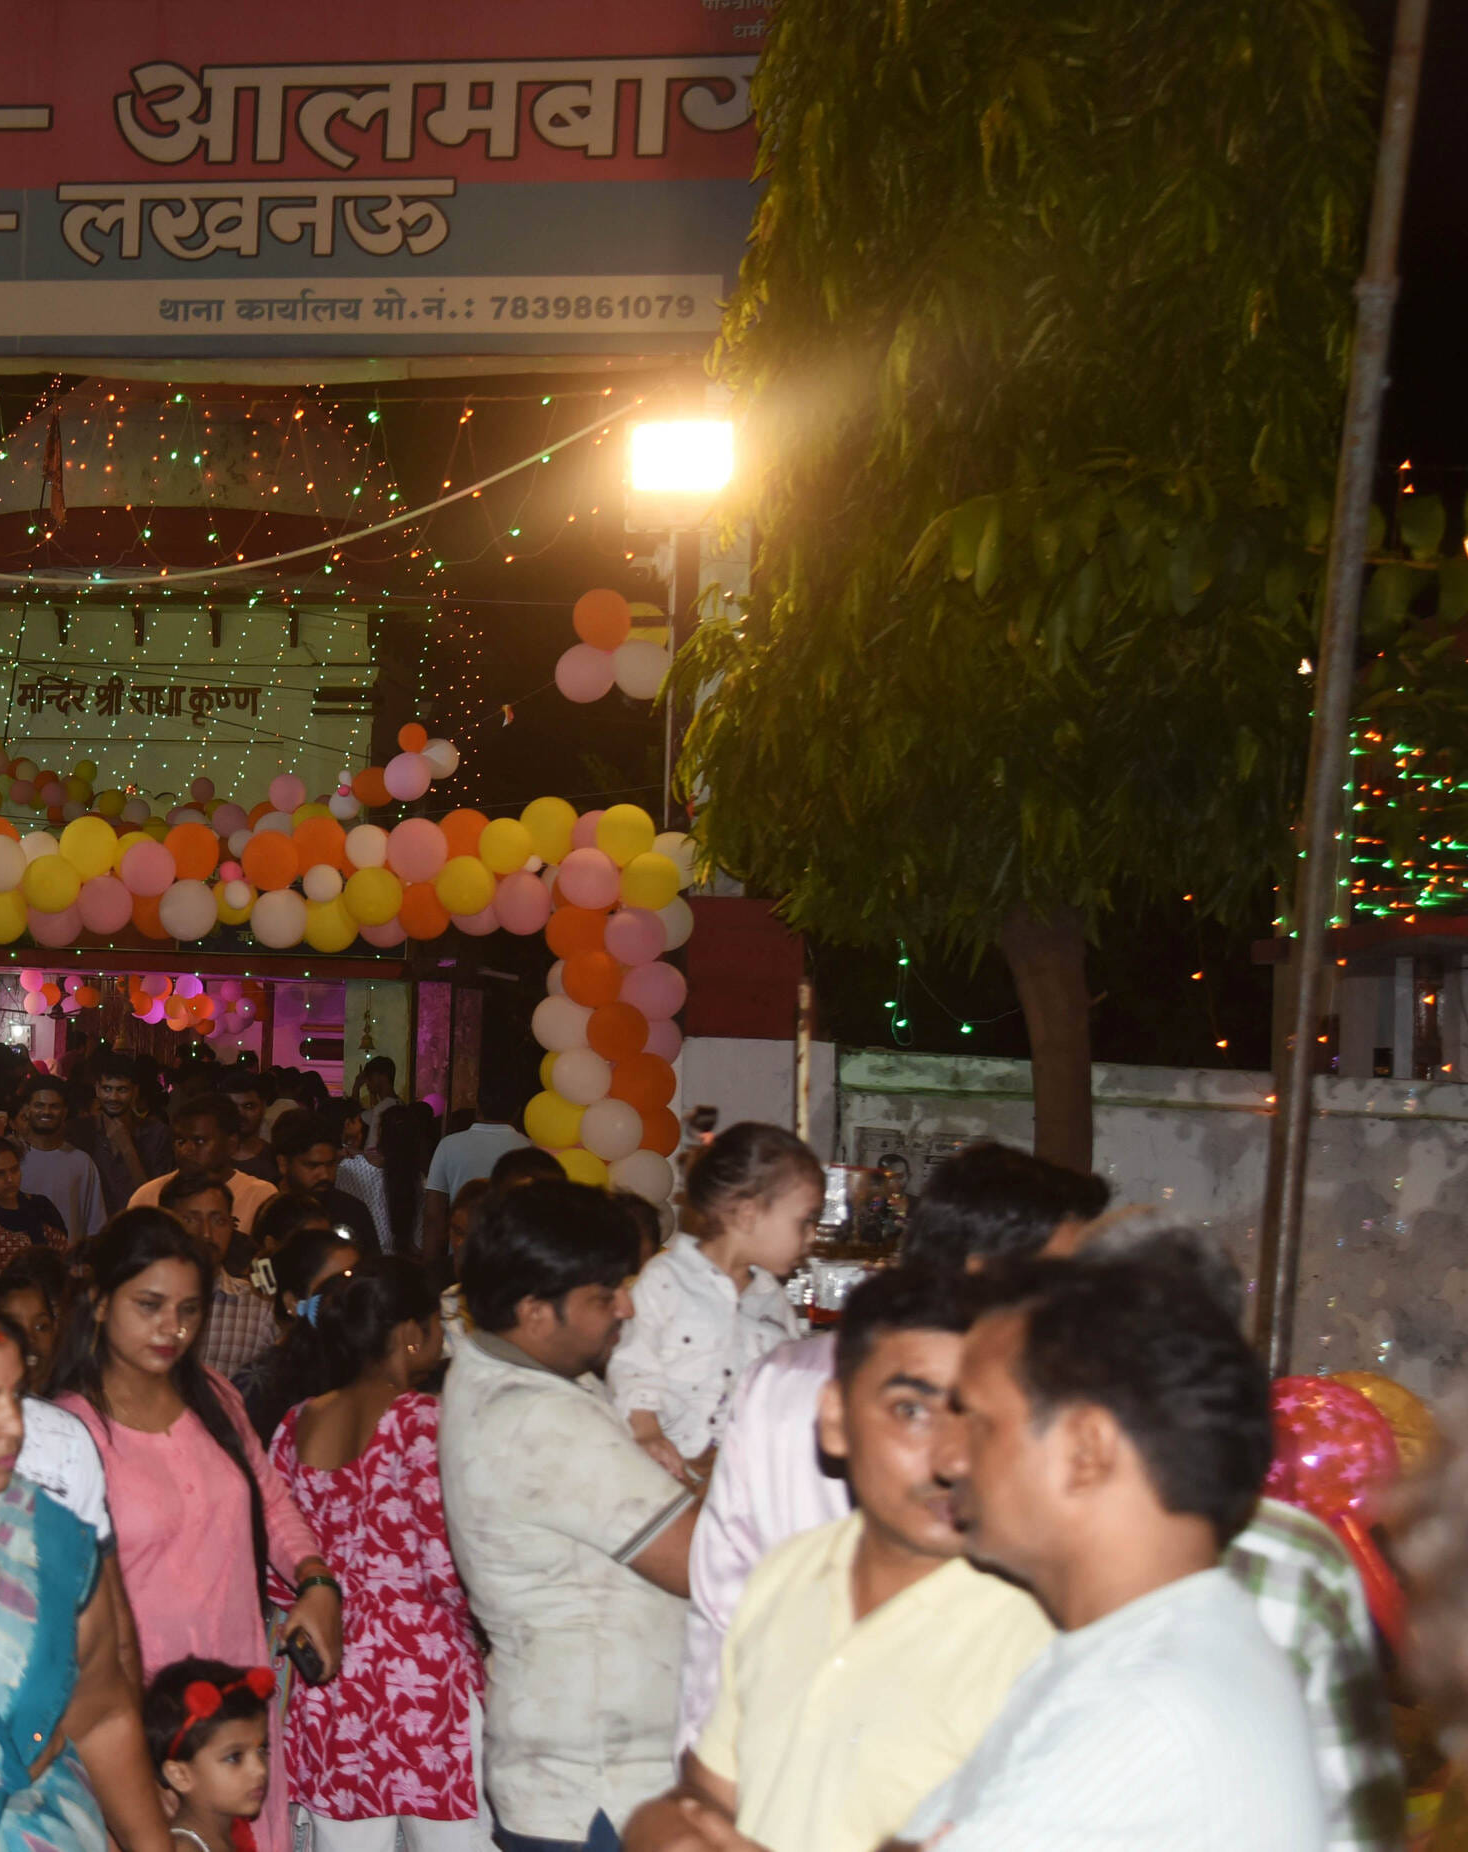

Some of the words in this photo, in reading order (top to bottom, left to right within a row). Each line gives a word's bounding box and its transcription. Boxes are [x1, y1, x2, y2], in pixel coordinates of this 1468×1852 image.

[57, 177, 456, 266] लखनऊ
[159, 298, 225, 323] थाना
[235, 288, 363, 322] कार्यालय
[489, 295, 697, 321] 7839861079
[16, 675, 88, 715] मन्दिर
[94, 675, 124, 717] श्री
[130, 685, 186, 717] राधा
[189, 686, 262, 726] कृष्ण
